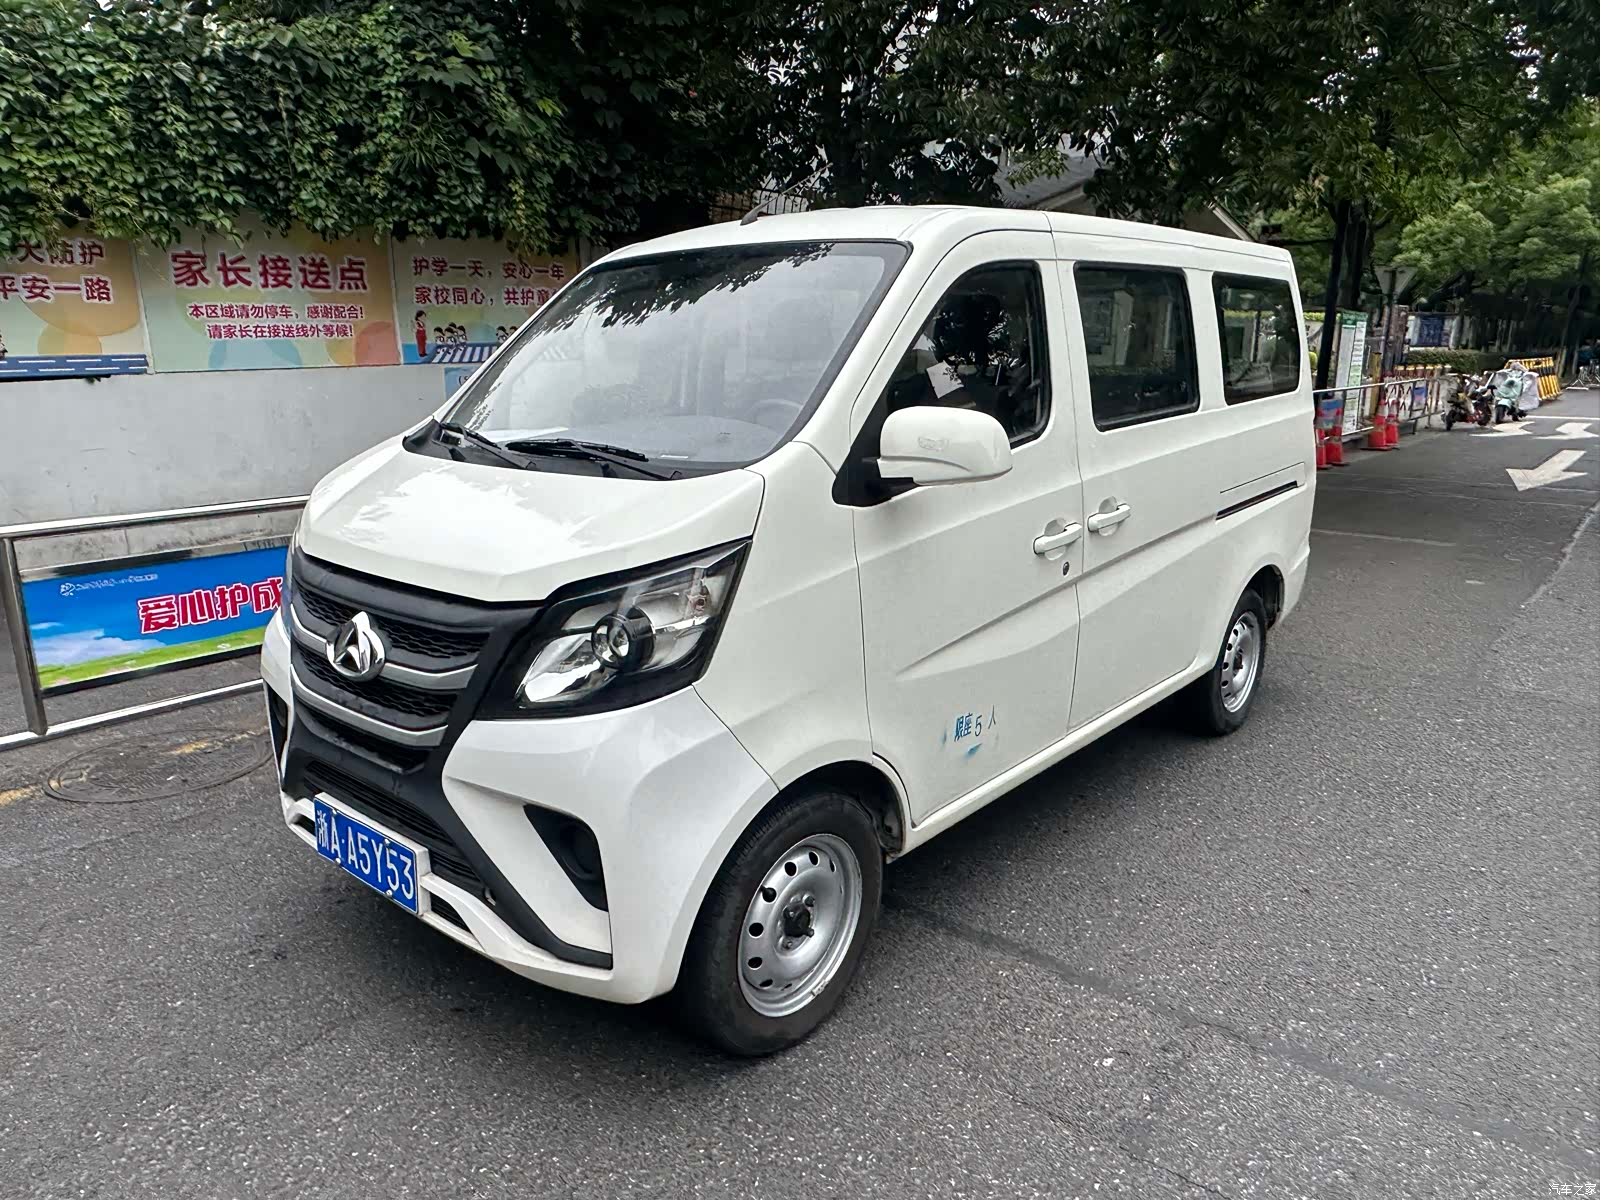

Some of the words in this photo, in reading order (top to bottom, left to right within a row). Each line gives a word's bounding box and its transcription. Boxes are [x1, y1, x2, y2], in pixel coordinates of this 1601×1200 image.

[170, 250, 368, 291] 家长接送点
[412, 256, 565, 281] 护学一天，安心一年
[0, 275, 111, 301] 平安一路
[415, 285, 557, 306] 家校同心，共护童
[188, 303, 364, 320] 本区域请勿停车，感谢配合！
[207, 324, 353, 339] 请家长在接送线外等候！
[138, 577, 283, 634] 爱心护成
